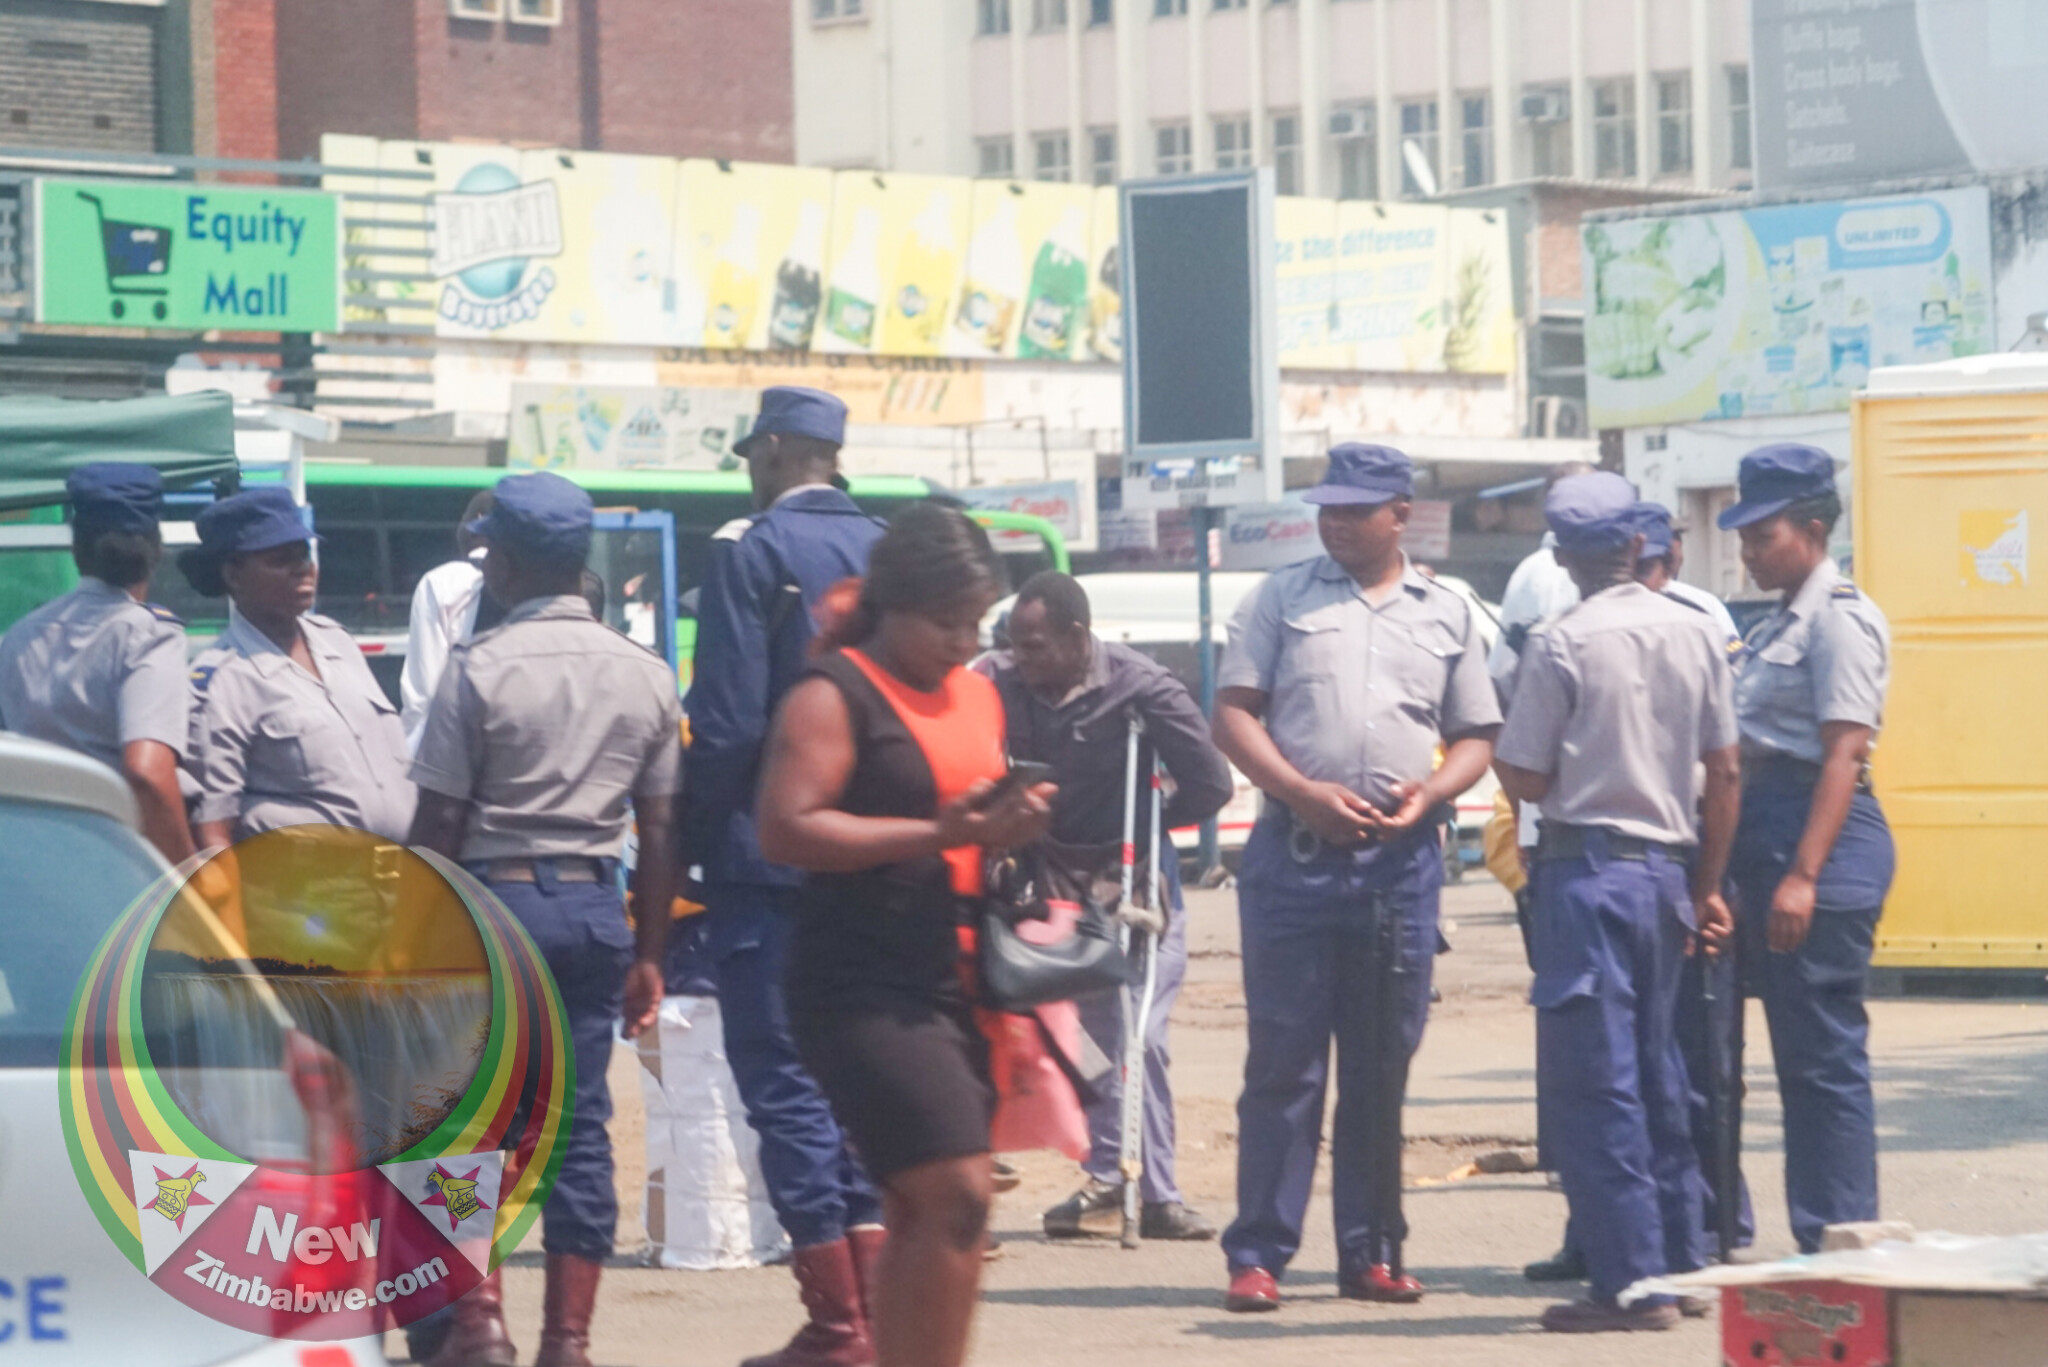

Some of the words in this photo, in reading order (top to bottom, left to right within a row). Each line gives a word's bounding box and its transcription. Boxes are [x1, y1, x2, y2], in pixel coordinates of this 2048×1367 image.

[187, 197, 306, 257] Equity
[1302, 235, 1335, 261] the
[1342, 226, 1437, 257] difference
[1844, 226, 1921, 244] UNLIMITED
[203, 273, 288, 317] Mall
[1230, 521, 1314, 544] EcoCash
